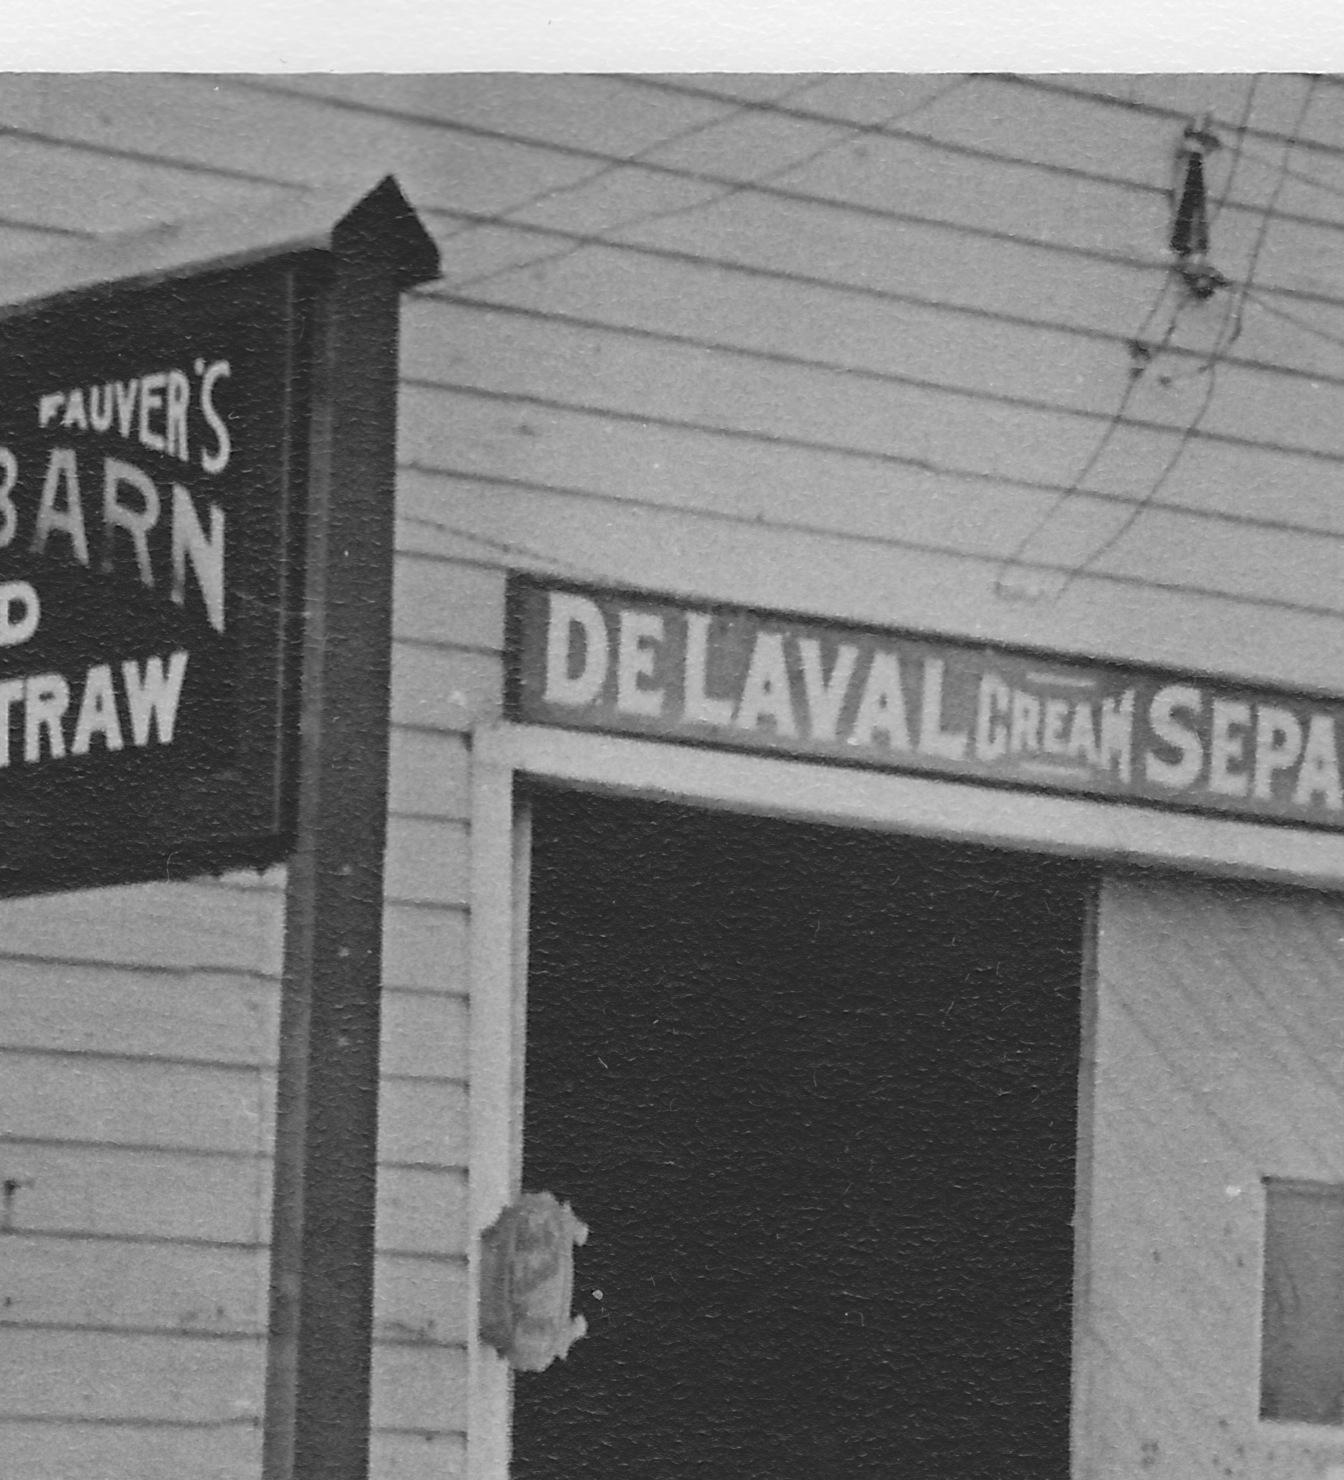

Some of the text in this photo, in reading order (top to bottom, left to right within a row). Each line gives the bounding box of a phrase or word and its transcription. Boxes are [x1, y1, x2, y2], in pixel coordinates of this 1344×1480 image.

[543, 590, 666, 716] DE
[679, 611, 968, 762] LAVAL
[974, 672, 1136, 783] CREAM
